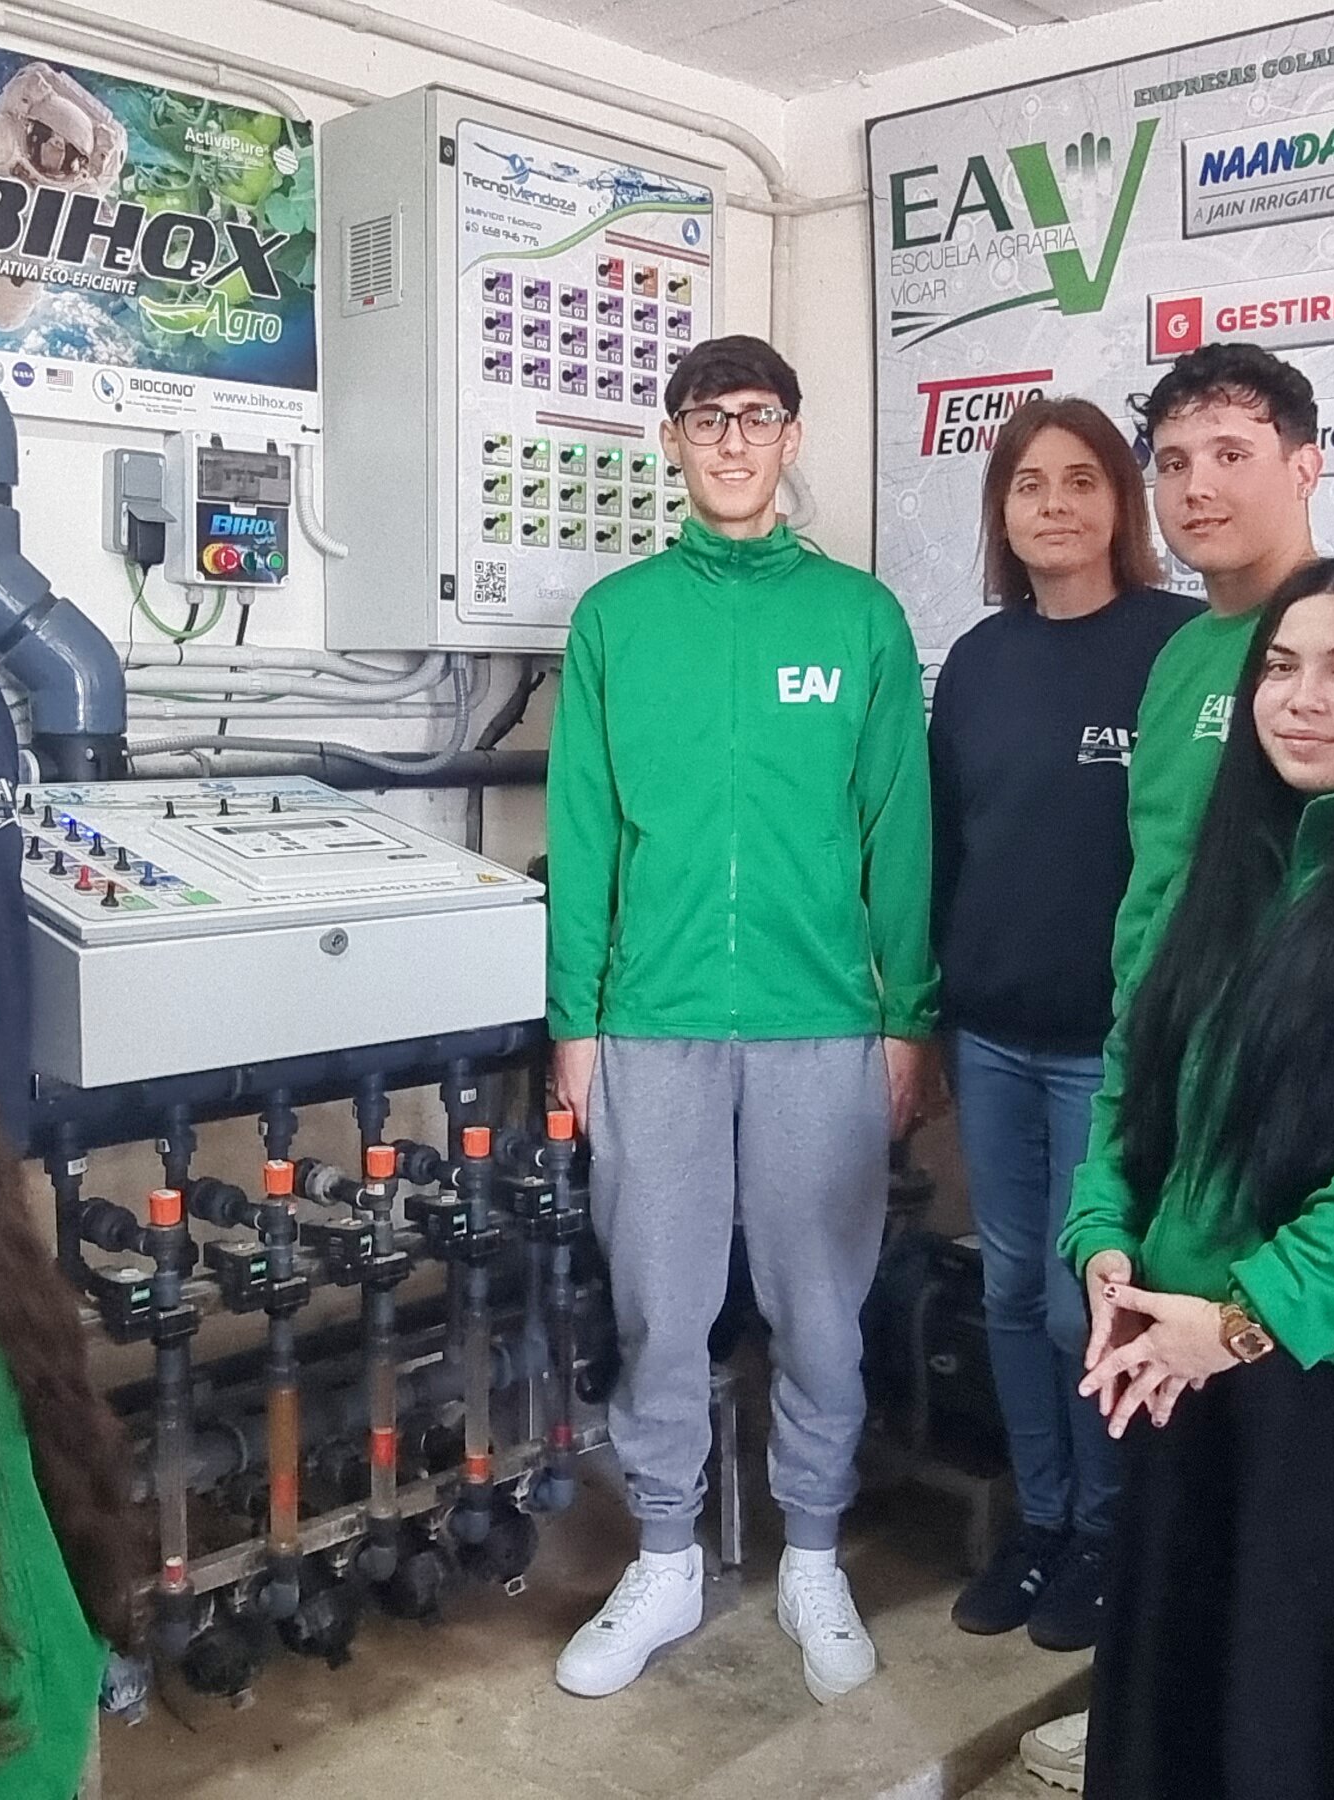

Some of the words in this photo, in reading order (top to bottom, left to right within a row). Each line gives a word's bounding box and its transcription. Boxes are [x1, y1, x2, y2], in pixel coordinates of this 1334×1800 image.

[1134, 63, 1257, 107] EMPRESAS
[1193, 209, 1204, 222] A
[1206, 199, 1245, 225] JAIN
[891, 243, 980, 277] ESCUELA
[986, 226, 1079, 262] AGRARIA
[42, 268, 137, 296] ECO-EFICIENTE
[891, 279, 947, 307] VÍCAR
[195, 291, 281, 344] Agro
[1167, 312, 1189, 339] G
[130, 378, 194, 398] BIOCONO
[213, 391, 303, 412] www.bihox.es
[209, 514, 277, 536] BIHOX
[777, 666, 841, 703] EAV
